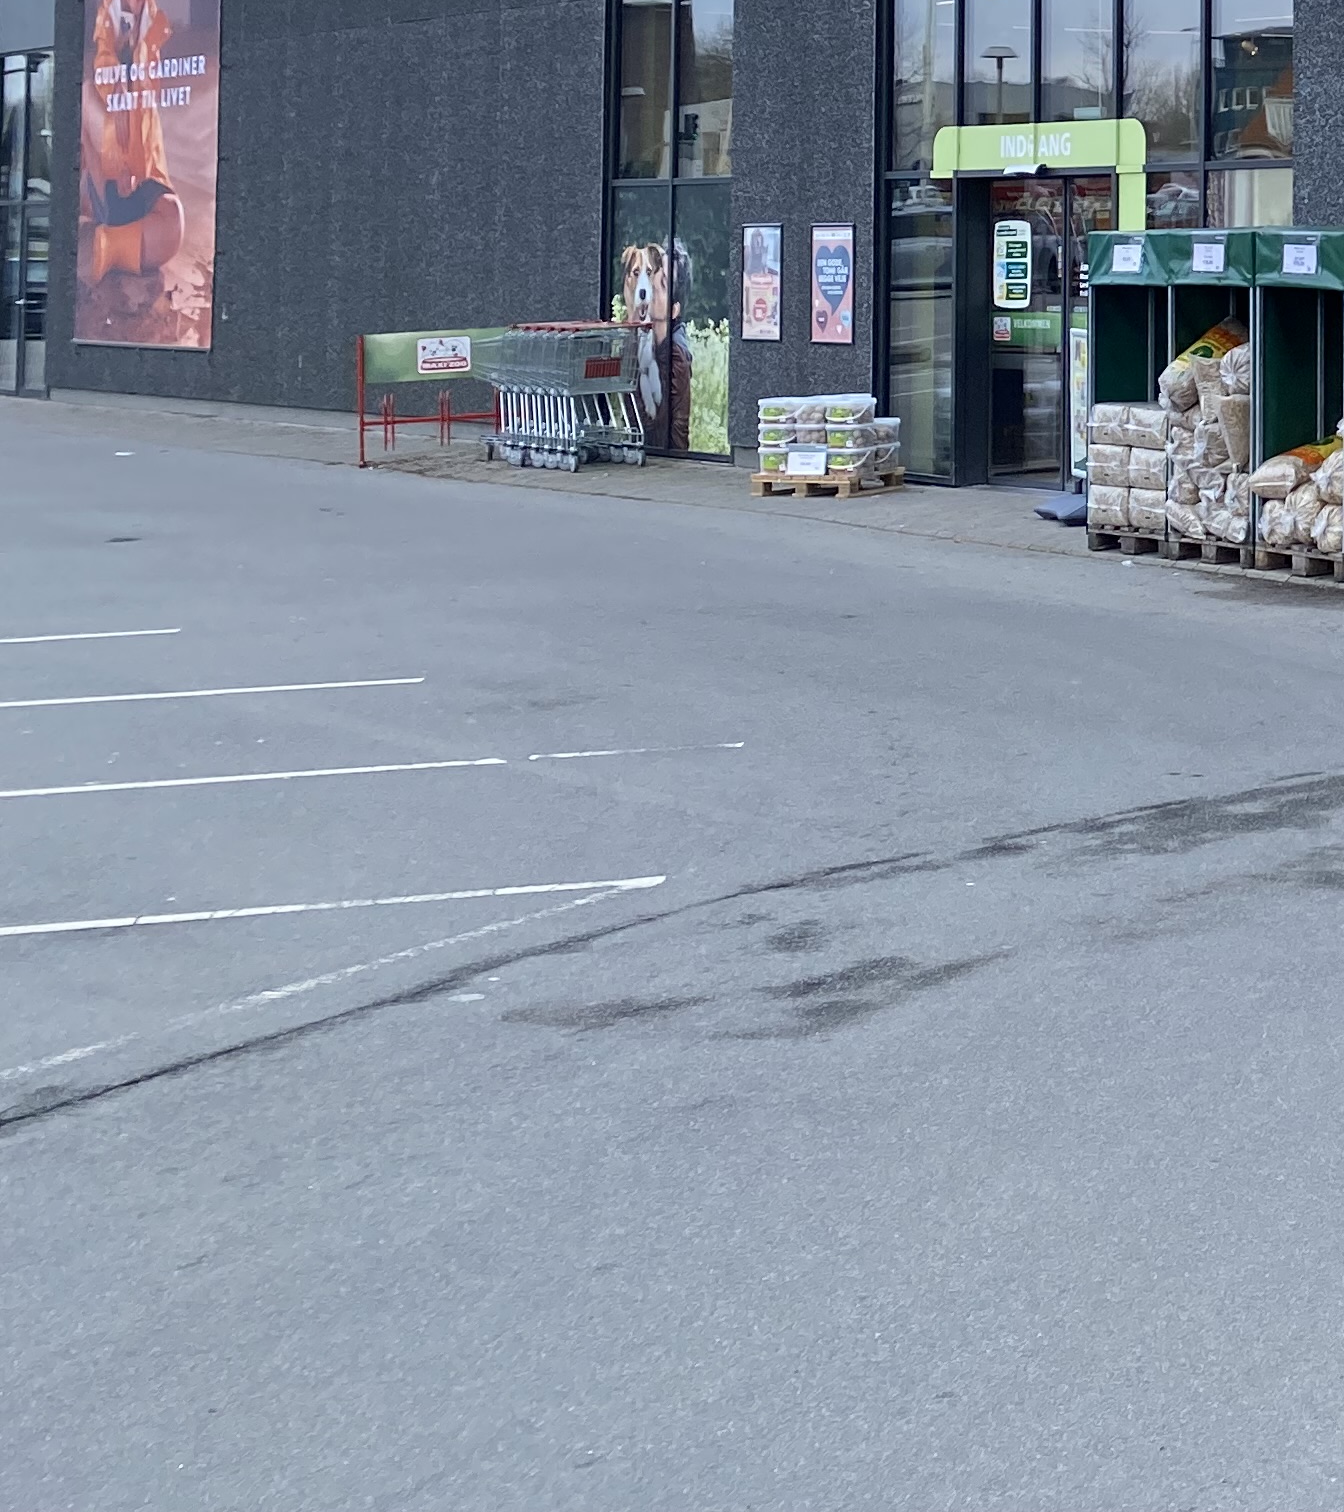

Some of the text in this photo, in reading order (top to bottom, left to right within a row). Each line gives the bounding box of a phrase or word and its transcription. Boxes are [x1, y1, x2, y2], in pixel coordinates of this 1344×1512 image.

[95, 55, 206, 85] GULVE OG GARDINER
[141, 90, 157, 108] TIL
[161, 86, 191, 107] LIVET
